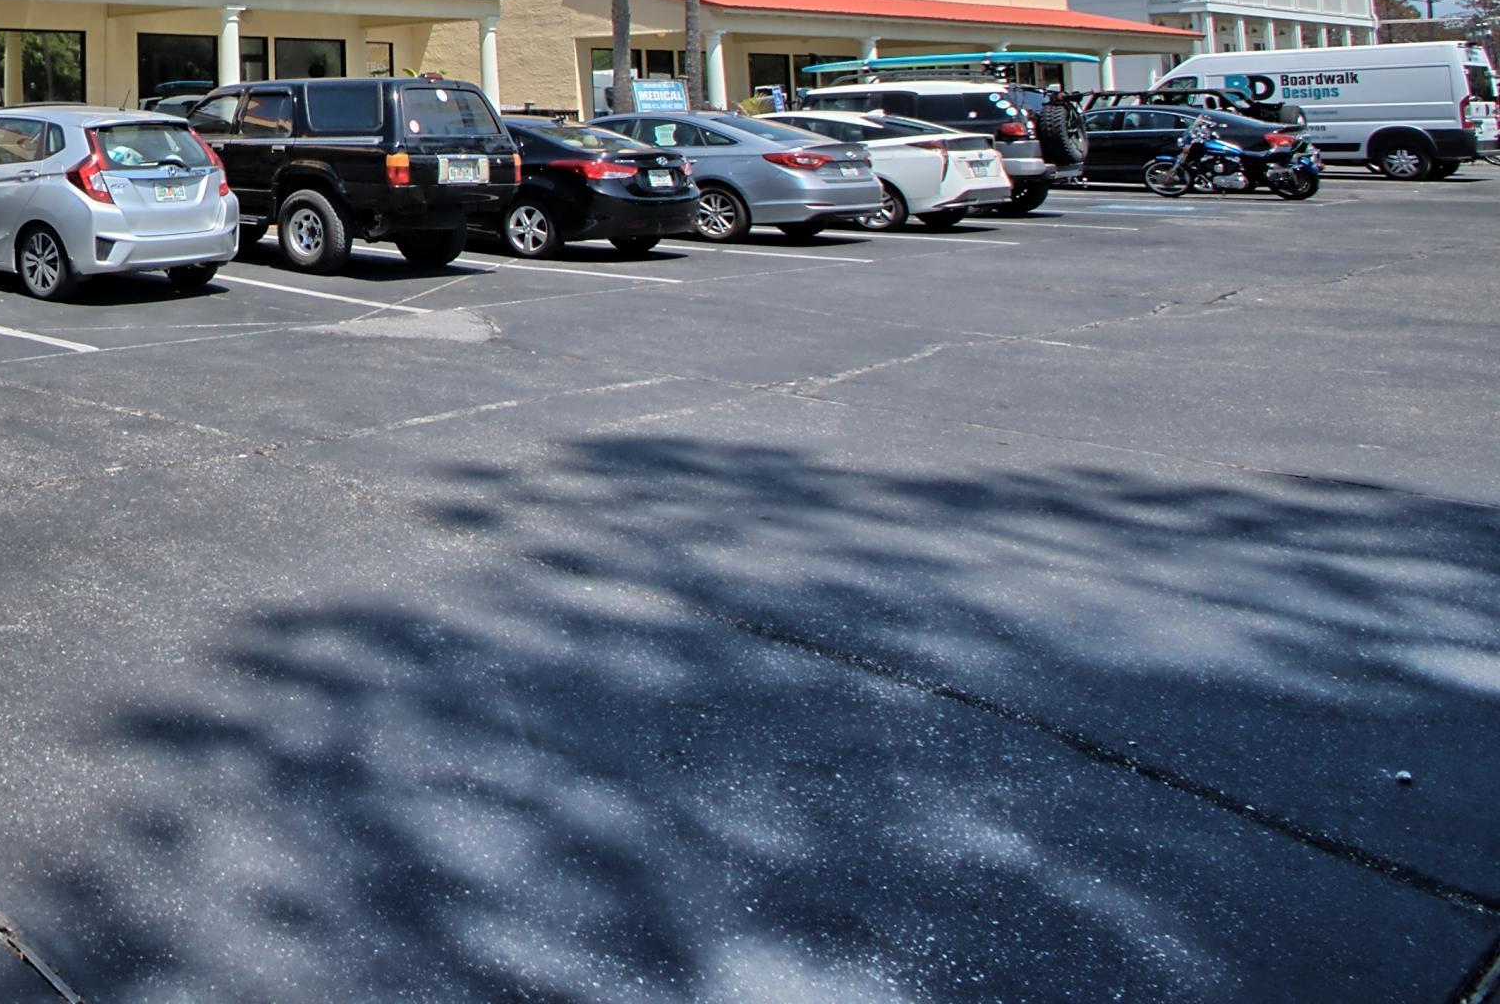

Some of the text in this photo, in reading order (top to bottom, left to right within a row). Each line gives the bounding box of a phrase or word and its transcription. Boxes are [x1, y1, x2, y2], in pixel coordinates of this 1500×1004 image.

[1280, 71, 1360, 87] Boardwalk
[637, 90, 684, 101] MEDICAL
[1282, 86, 1340, 101] Designs
